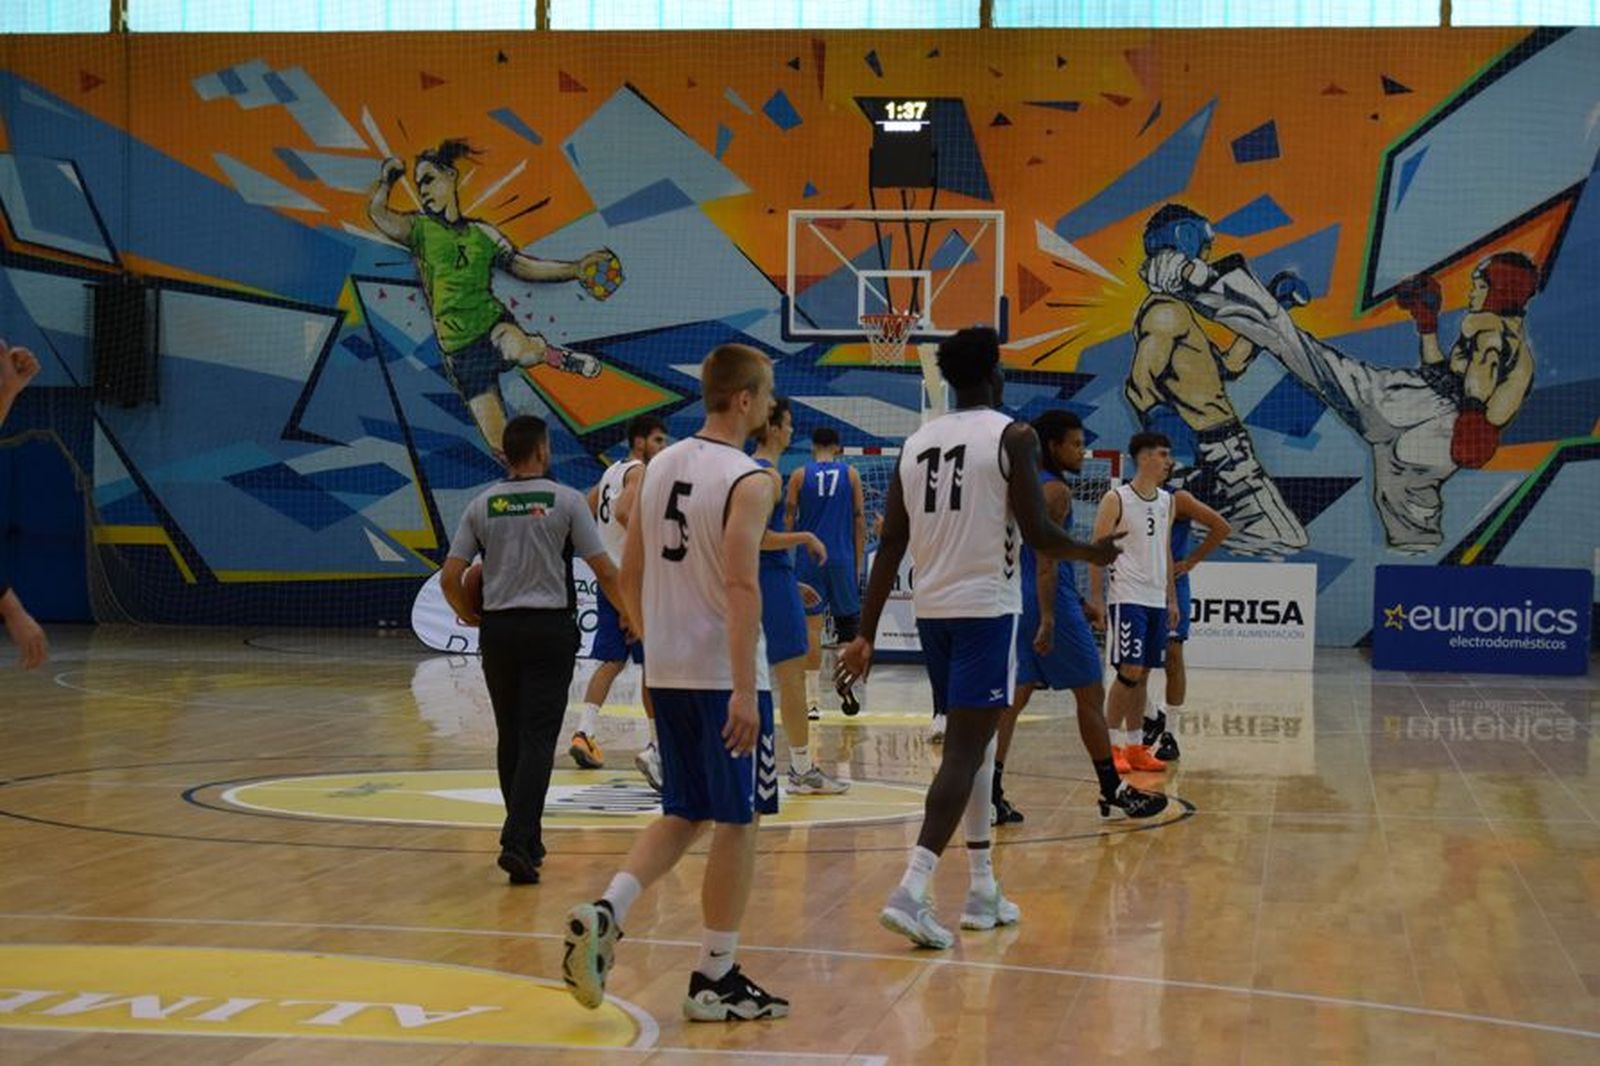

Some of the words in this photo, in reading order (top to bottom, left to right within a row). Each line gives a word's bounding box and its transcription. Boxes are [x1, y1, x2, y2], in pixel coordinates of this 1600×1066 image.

[885, 101, 927, 120] 1:37
[815, 469, 839, 497] 17
[916, 444, 966, 513] 11
[661, 480, 693, 562] 5
[1146, 517, 1155, 536] 3
[1408, 600, 1578, 635] euronics
[1132, 639, 1143, 658] 3
[1449, 634, 1567, 651] electrodomésticos
